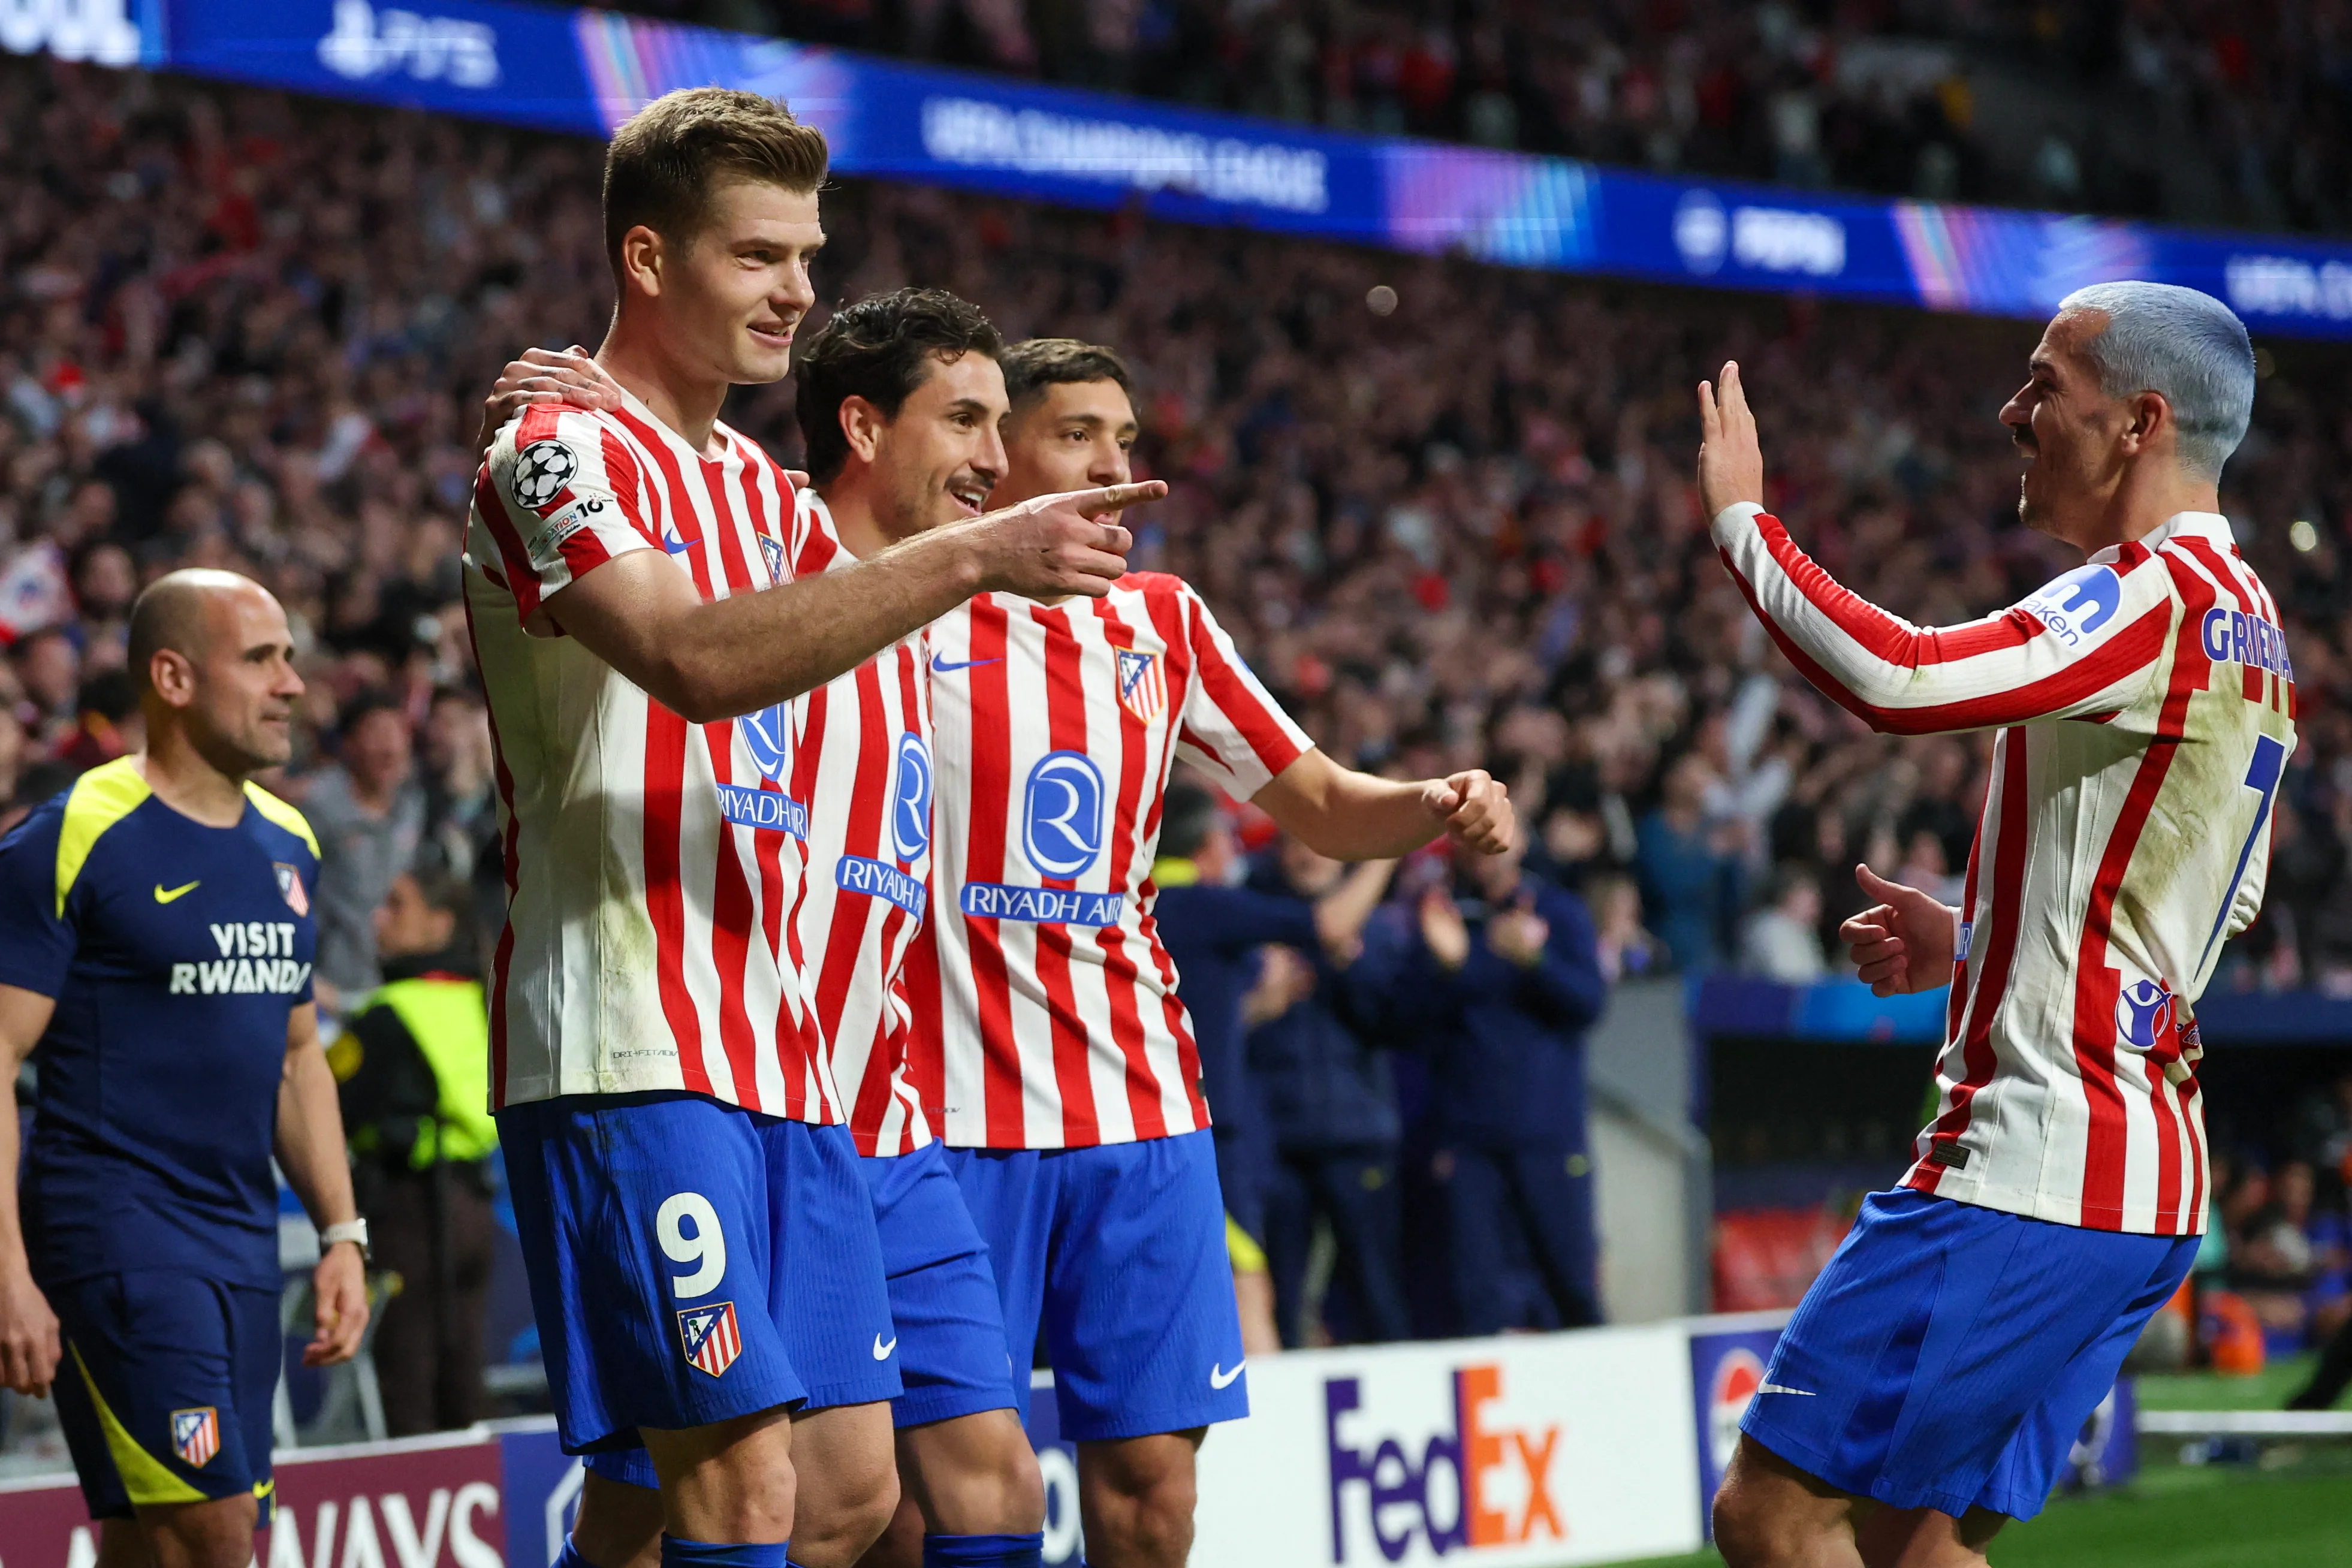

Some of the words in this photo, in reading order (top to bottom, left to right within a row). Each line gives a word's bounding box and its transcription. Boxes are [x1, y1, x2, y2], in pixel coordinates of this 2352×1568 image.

[2022, 598, 2079, 646] aken
[2202, 607, 2294, 683] GRIEZMA
[717, 788, 791, 827] RIYADH
[2193, 732, 2285, 983] 7
[843, 859, 915, 909] RIYADH
[969, 885, 1081, 921] RIYADH
[1086, 896, 1121, 924] AIR
[209, 921, 295, 958] VISIT
[656, 1192, 726, 1298] 9
[1323, 1362, 1568, 1564] FedEx
